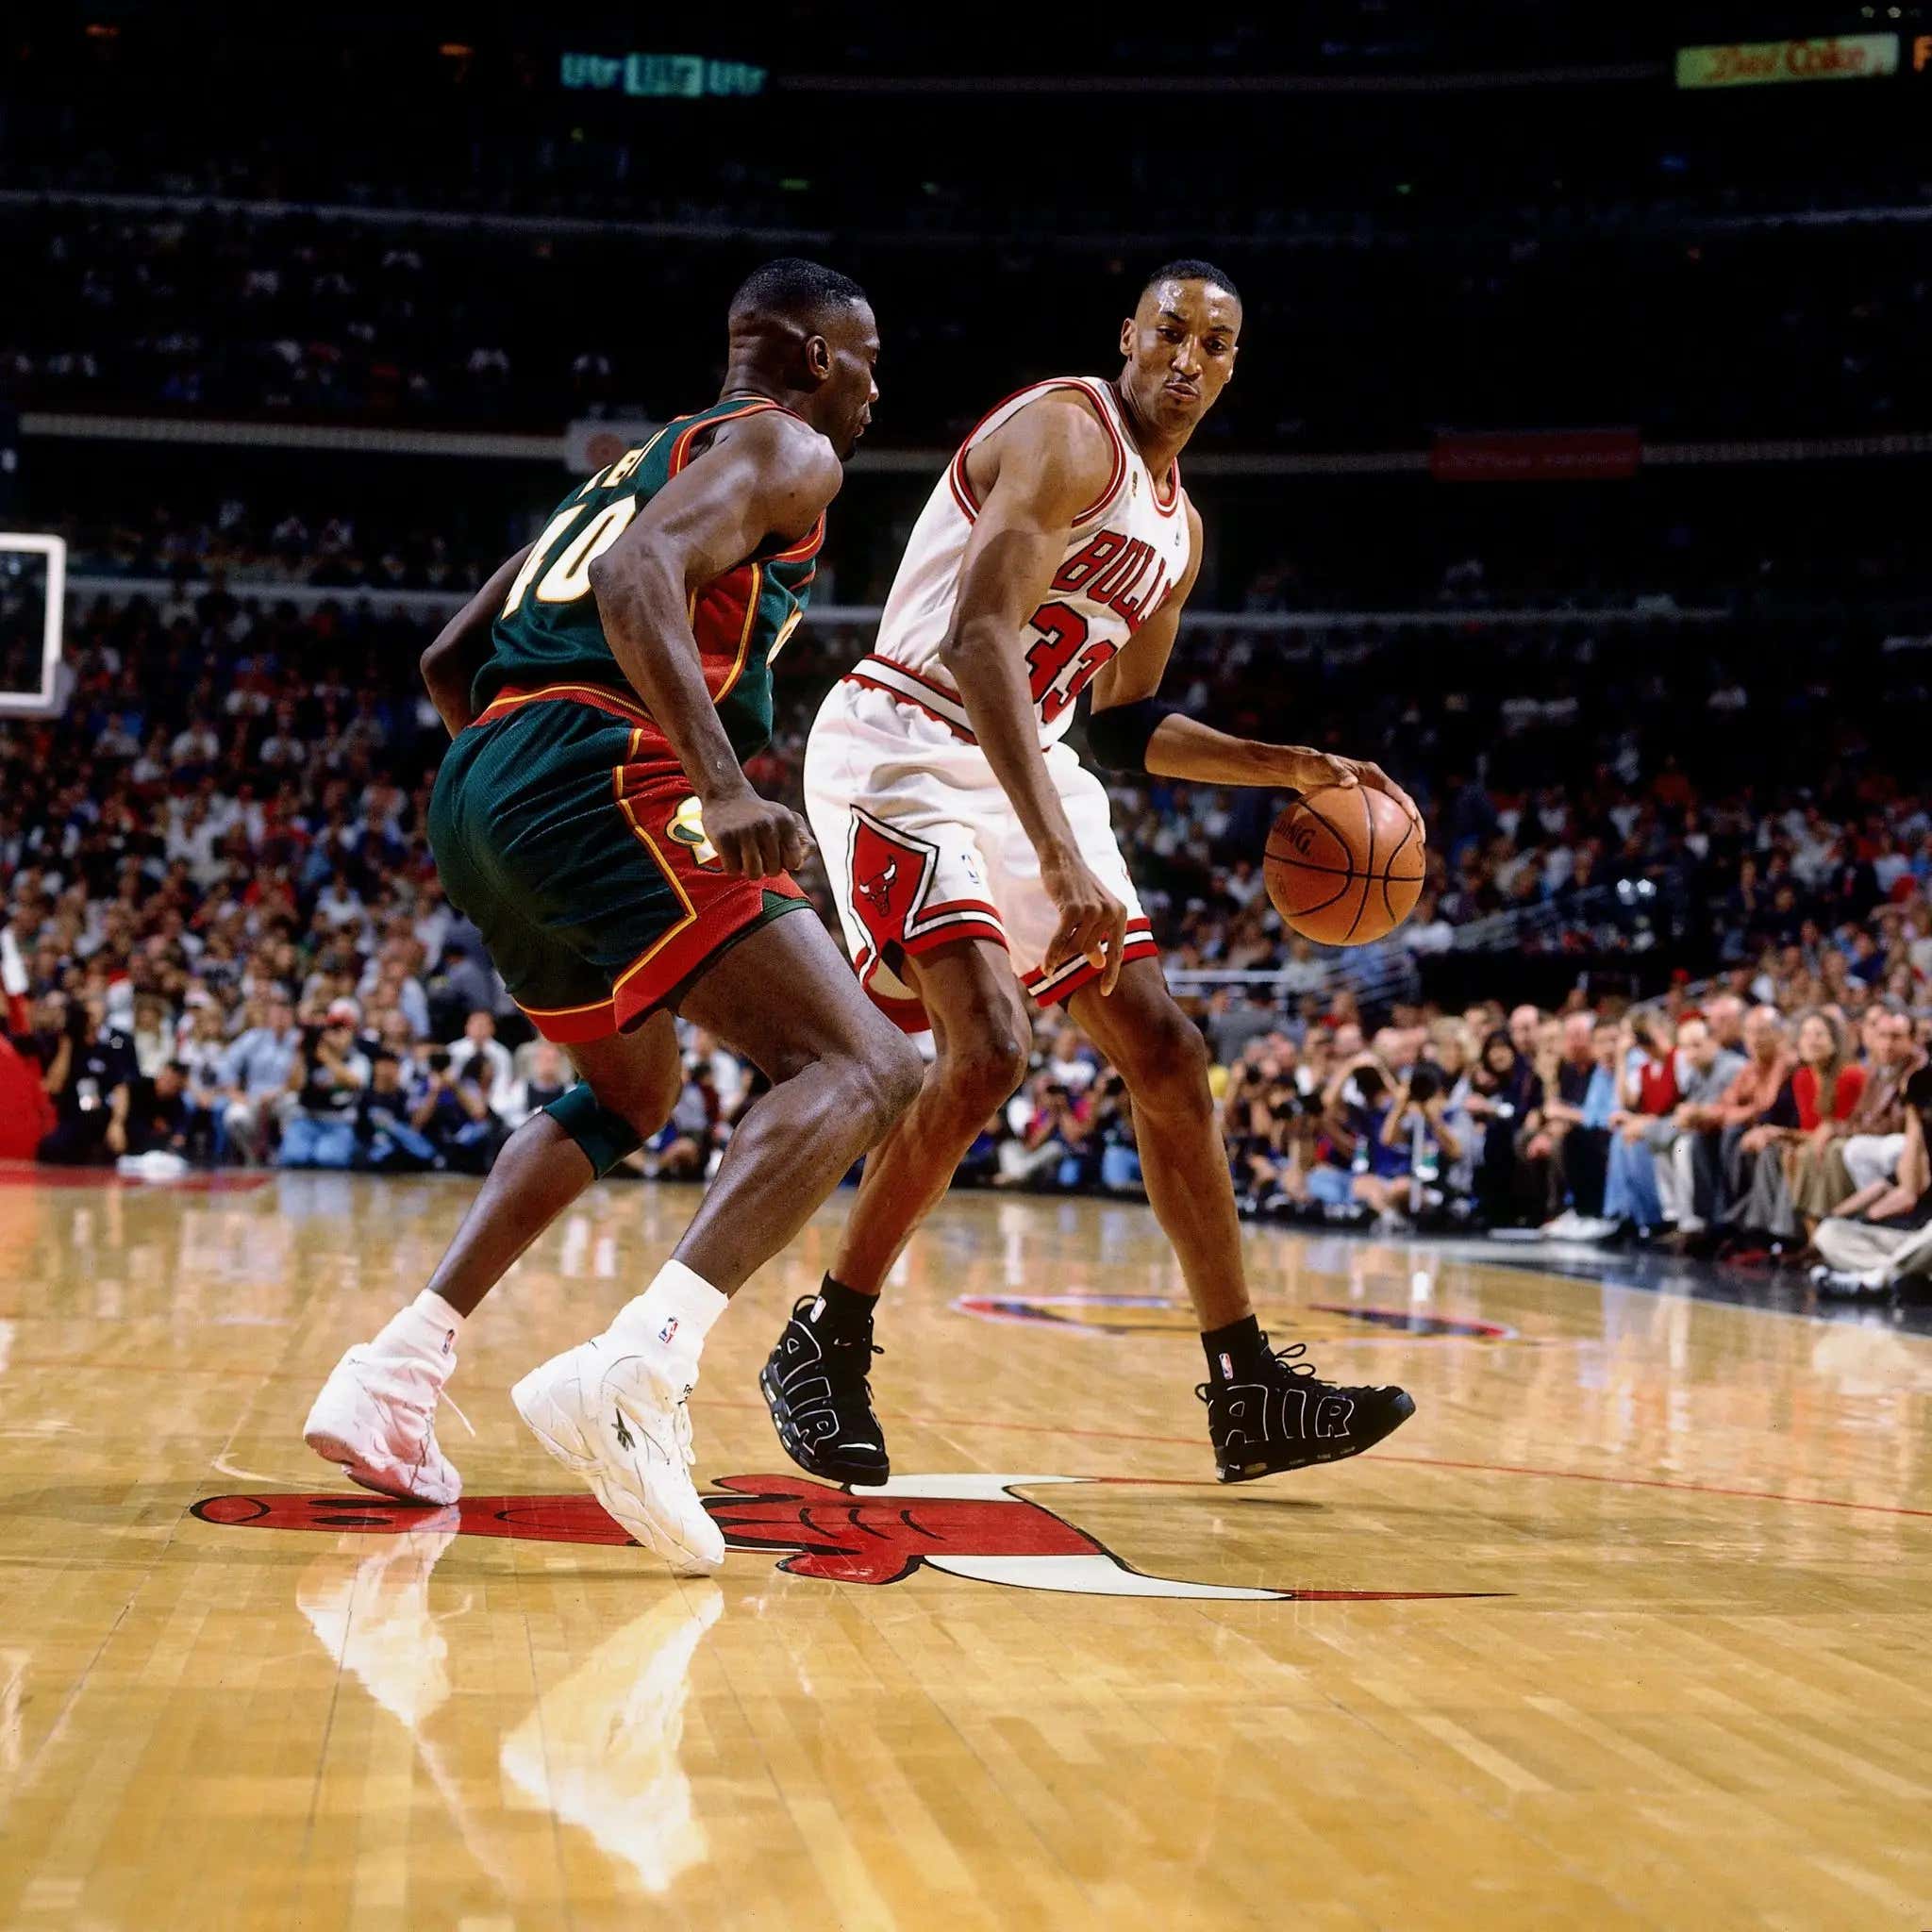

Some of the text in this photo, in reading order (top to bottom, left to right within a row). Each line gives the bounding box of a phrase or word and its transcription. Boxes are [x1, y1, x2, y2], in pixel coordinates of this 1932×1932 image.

[501, 494, 636, 620] 40
[1024, 601, 1119, 724] 33
[774, 1318, 841, 1457] AIR
[1217, 1383, 1356, 1447] AIR
